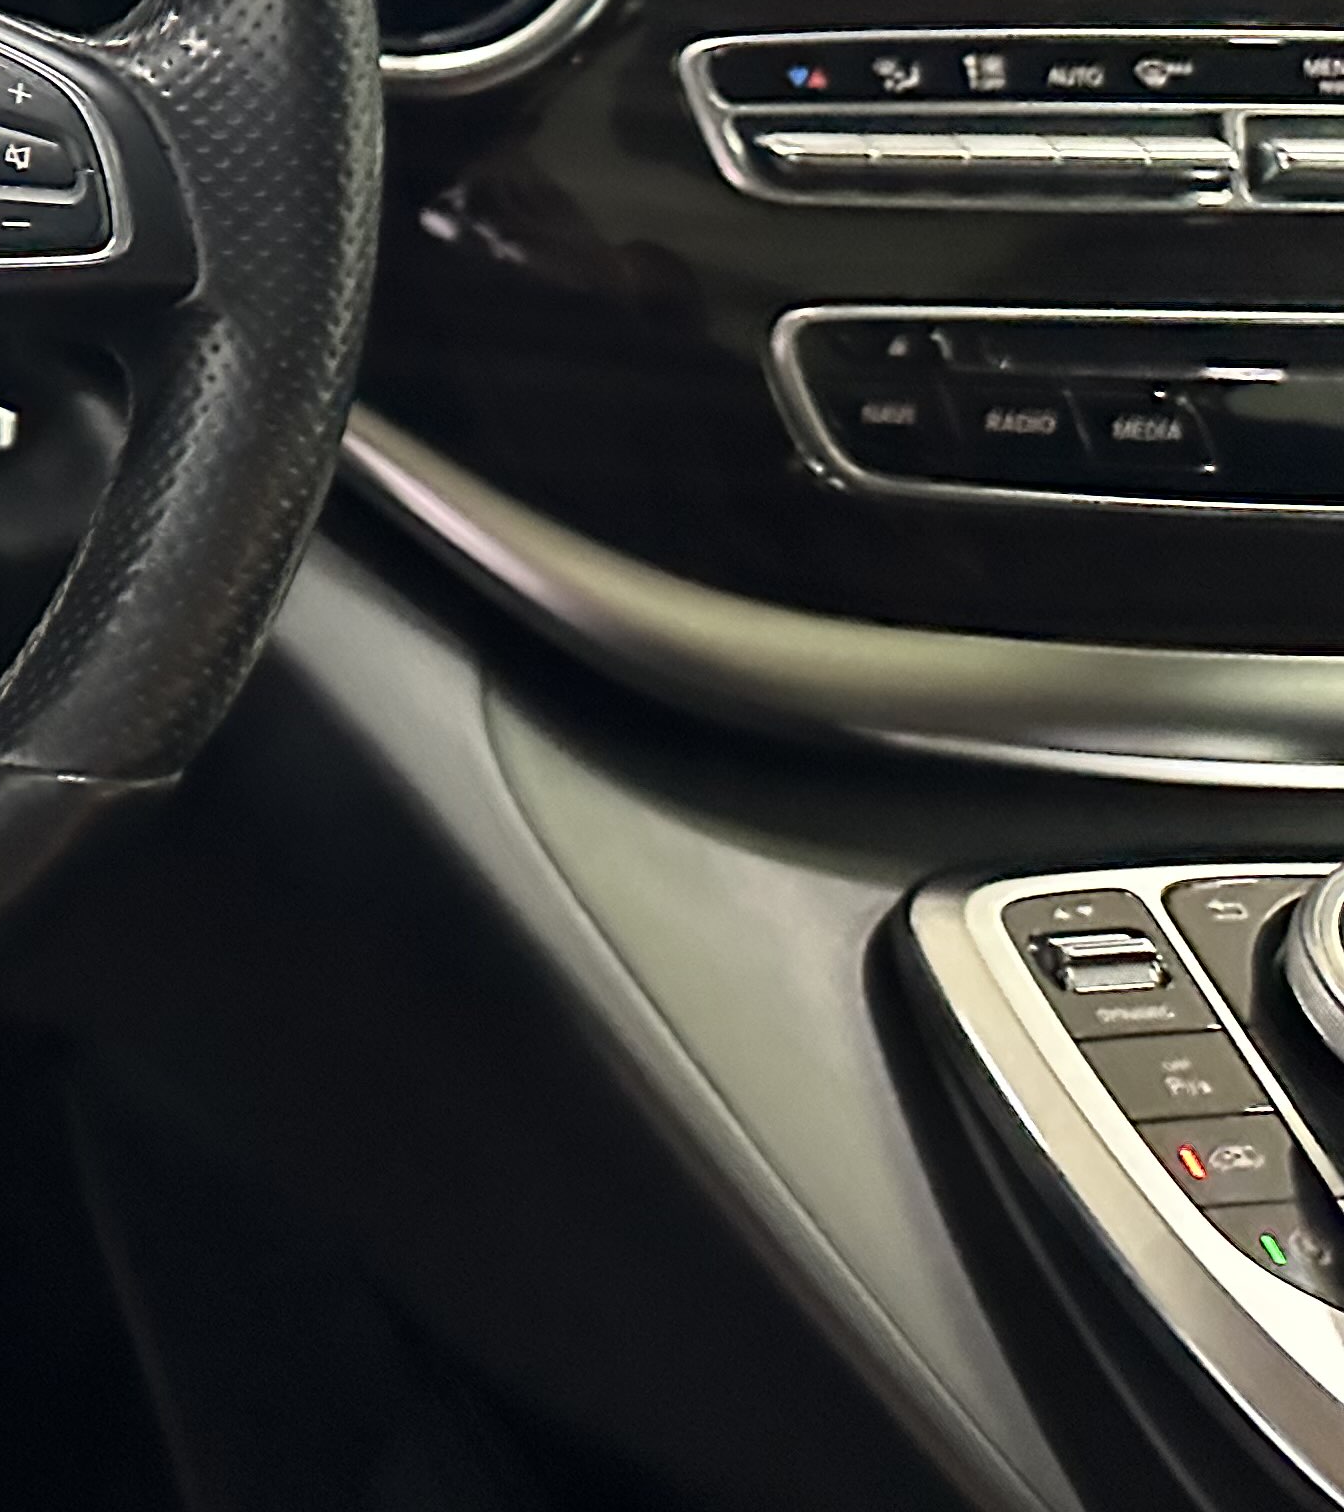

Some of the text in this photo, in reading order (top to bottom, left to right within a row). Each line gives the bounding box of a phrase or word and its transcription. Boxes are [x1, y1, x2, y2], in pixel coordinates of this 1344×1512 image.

[1047, 65, 1105, 88] AUTO
[984, 409, 1058, 436] RADIO
[1111, 416, 1184, 442] MEDIA
